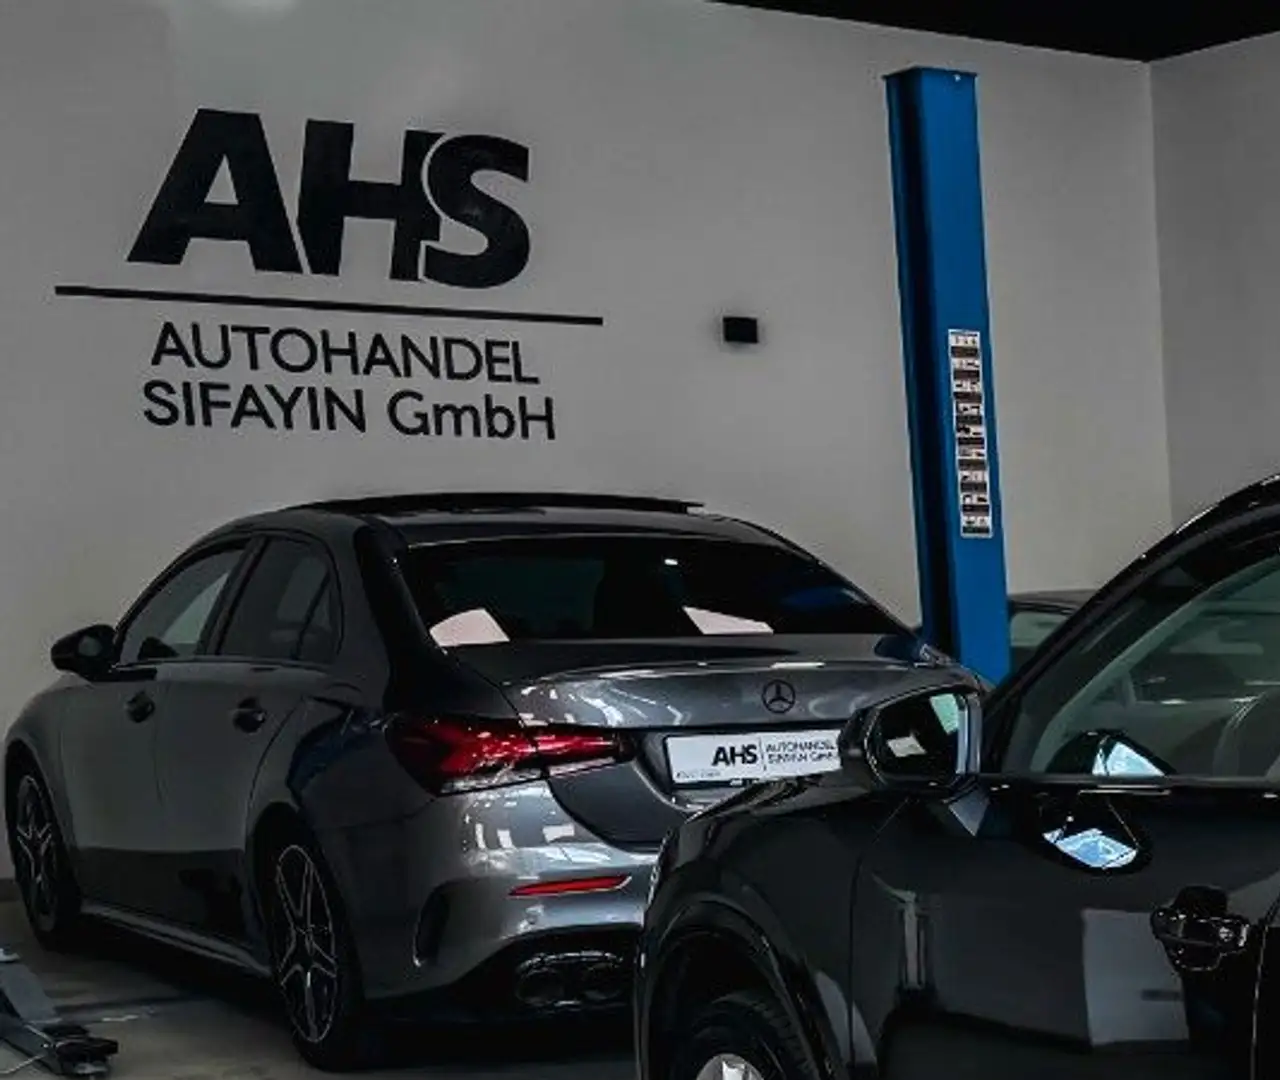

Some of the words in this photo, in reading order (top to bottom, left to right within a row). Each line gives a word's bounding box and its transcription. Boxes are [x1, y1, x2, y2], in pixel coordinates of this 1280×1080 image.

[127, 108, 531, 288] AHS
[150, 320, 541, 386] AUTOHANDEL
[142, 378, 367, 434] SIFAYIN
[386, 390, 557, 441] GmbH
[711, 743, 759, 767] AHS
